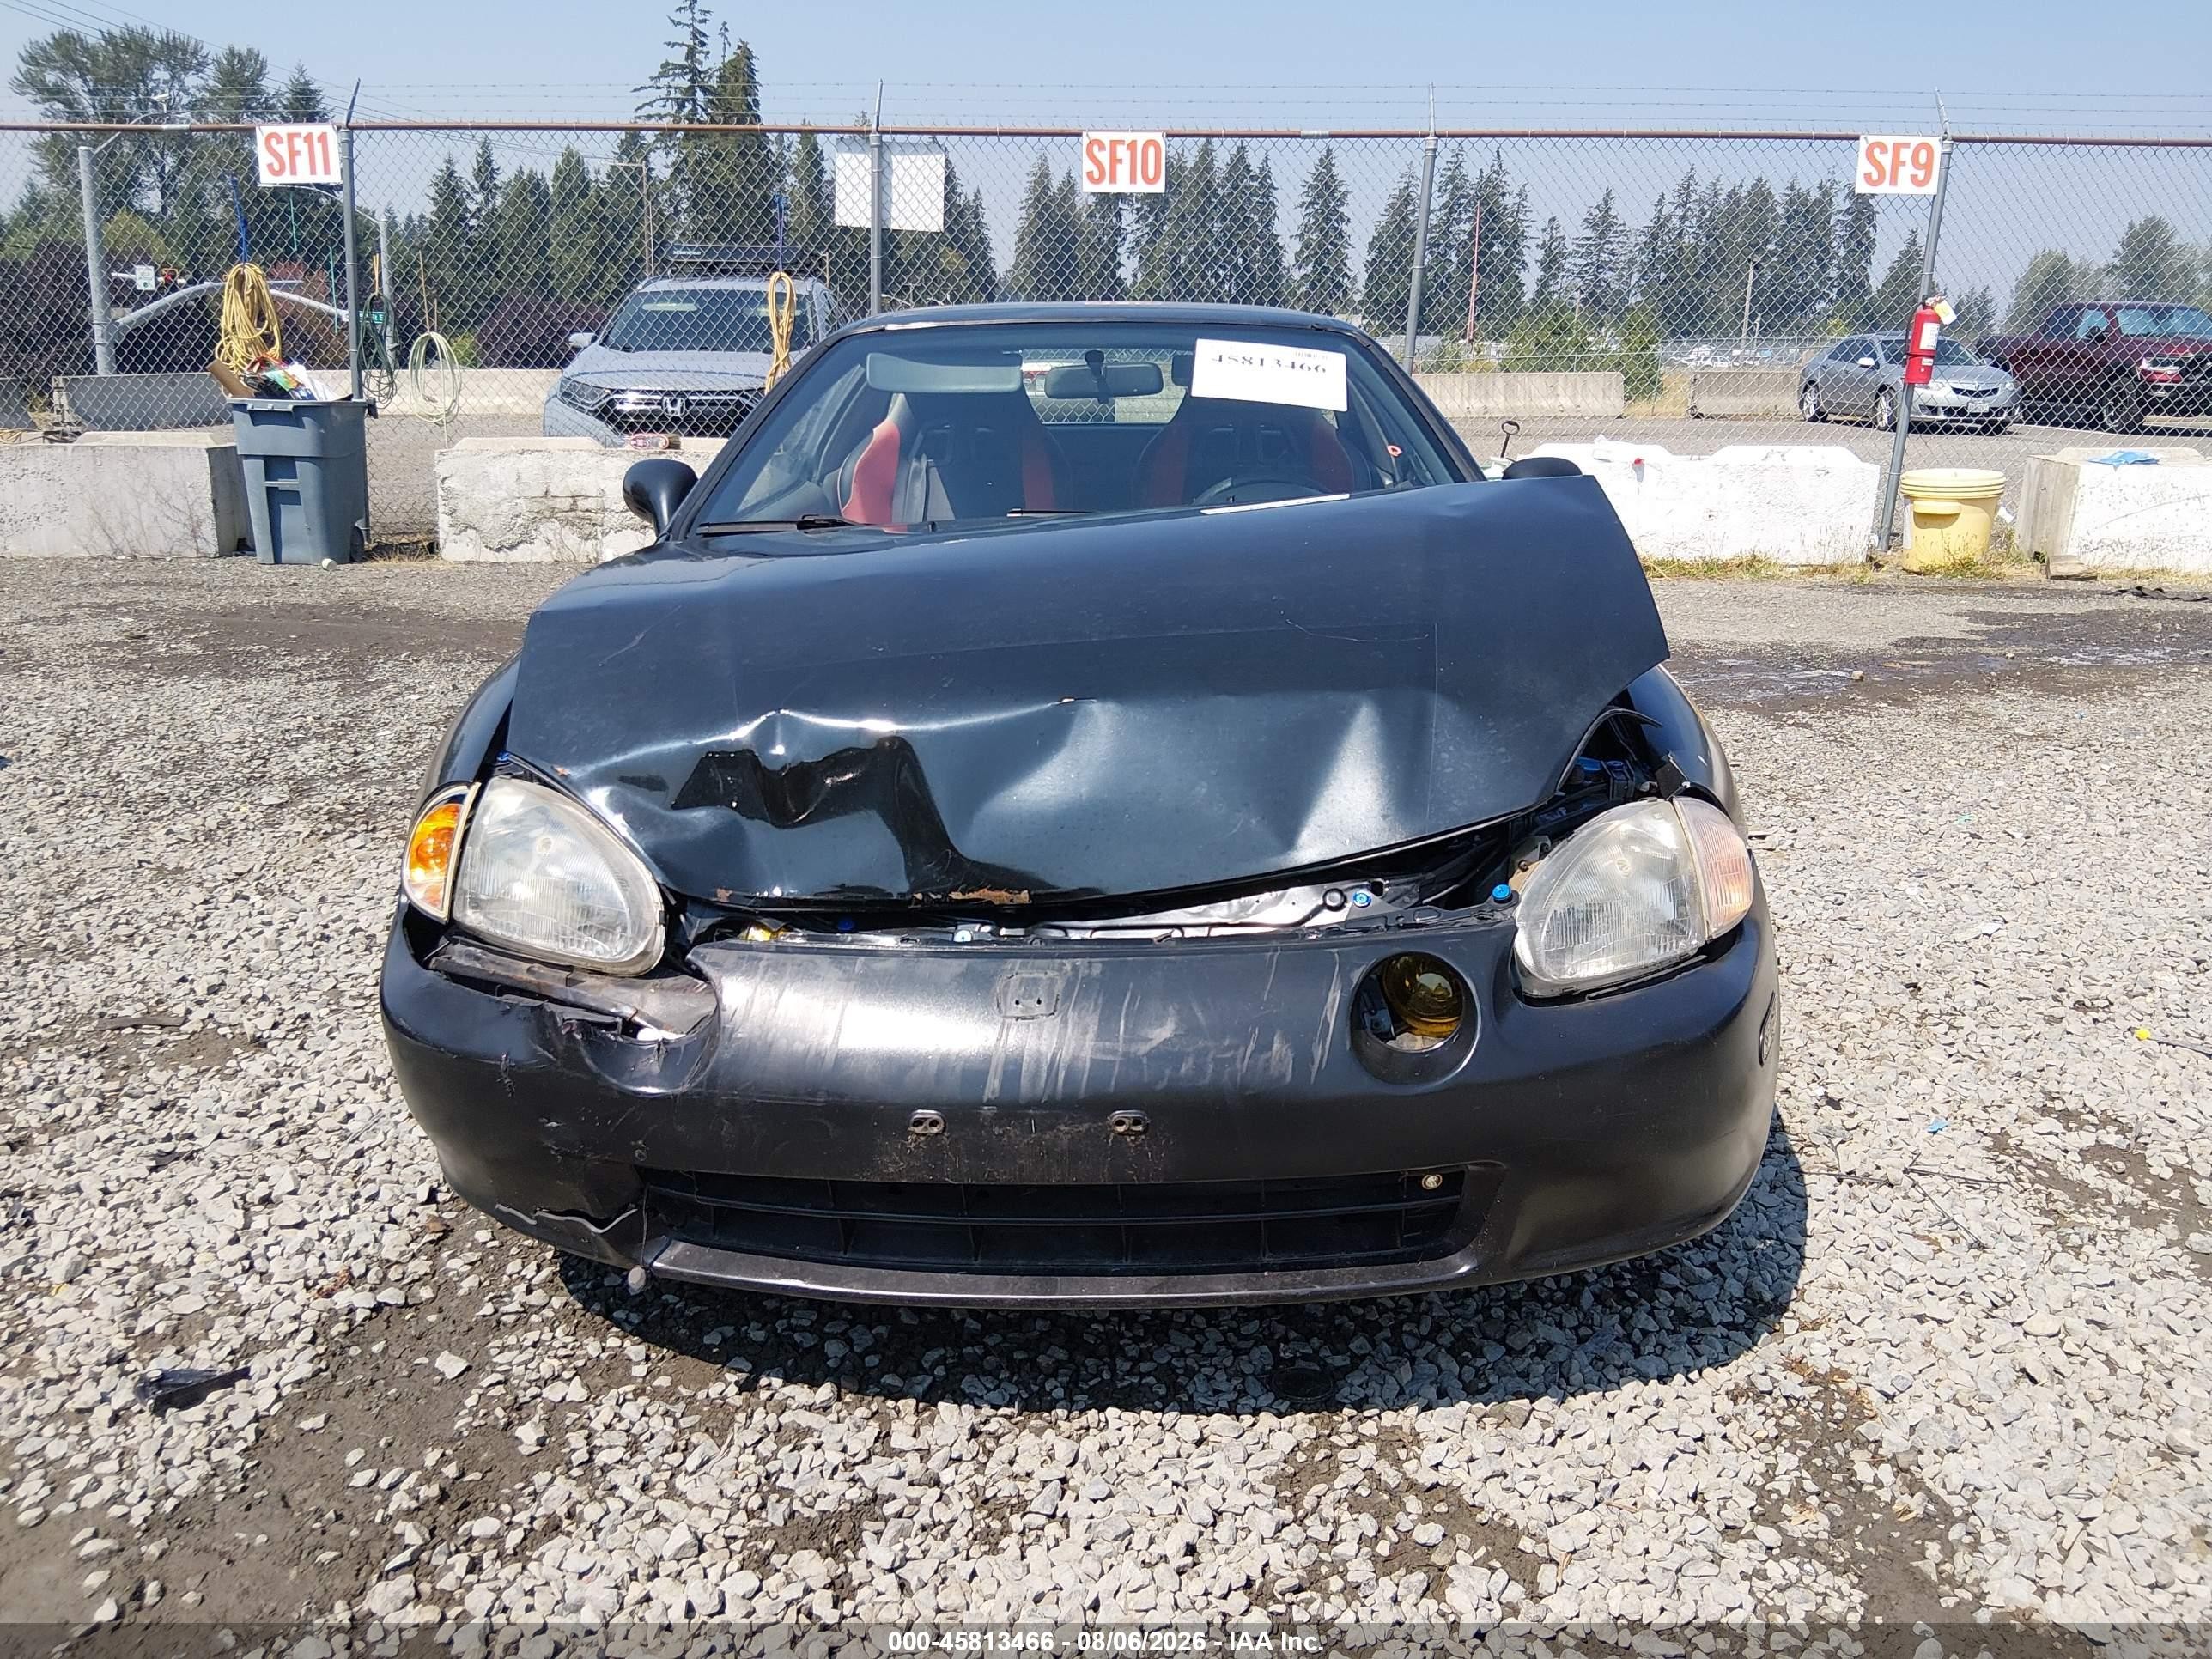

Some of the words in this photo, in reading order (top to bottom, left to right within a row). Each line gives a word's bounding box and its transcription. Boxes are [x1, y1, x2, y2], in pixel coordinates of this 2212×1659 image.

[264, 131, 331, 177] SF11
[1085, 138, 1162, 185] SF10
[1863, 141, 1935, 187] SF9
